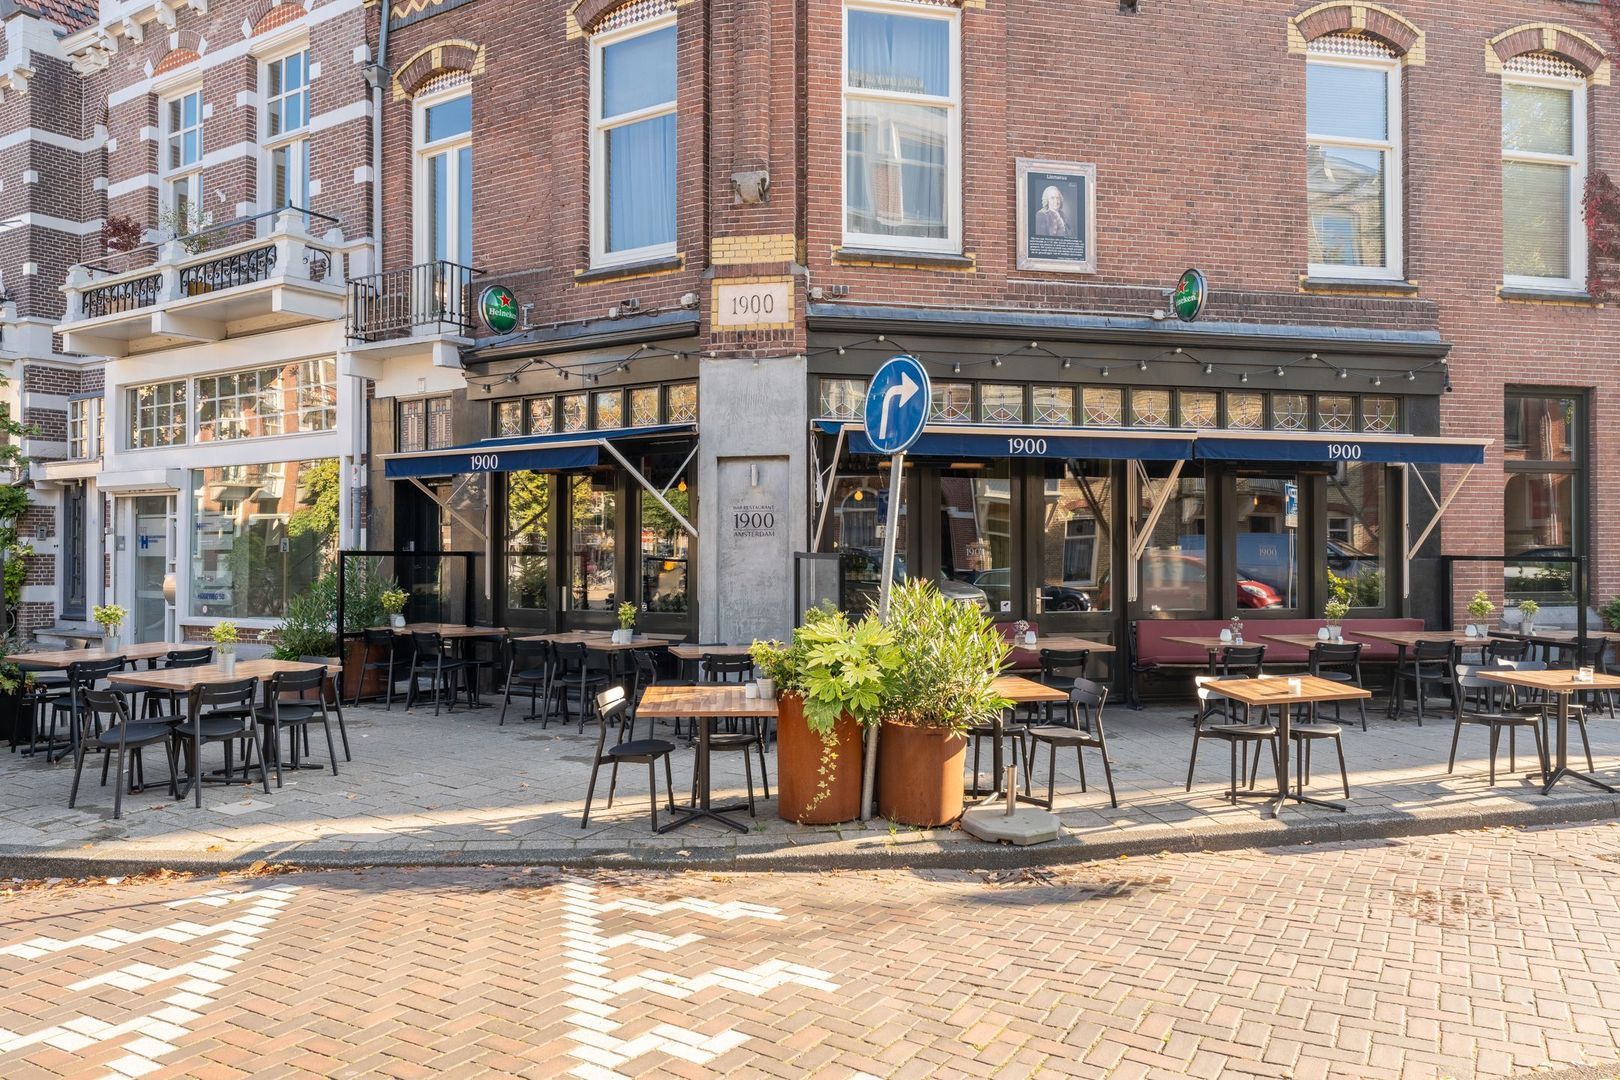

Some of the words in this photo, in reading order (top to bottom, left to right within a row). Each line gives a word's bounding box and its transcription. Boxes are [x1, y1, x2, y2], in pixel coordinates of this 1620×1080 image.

[732, 293, 774, 315] 1900
[489, 307, 517, 320] Heineke
[1007, 438, 1047, 455] 1900
[1327, 444, 1362, 460] 1900
[470, 454, 499, 471] 1900
[733, 512, 775, 529] 1900
